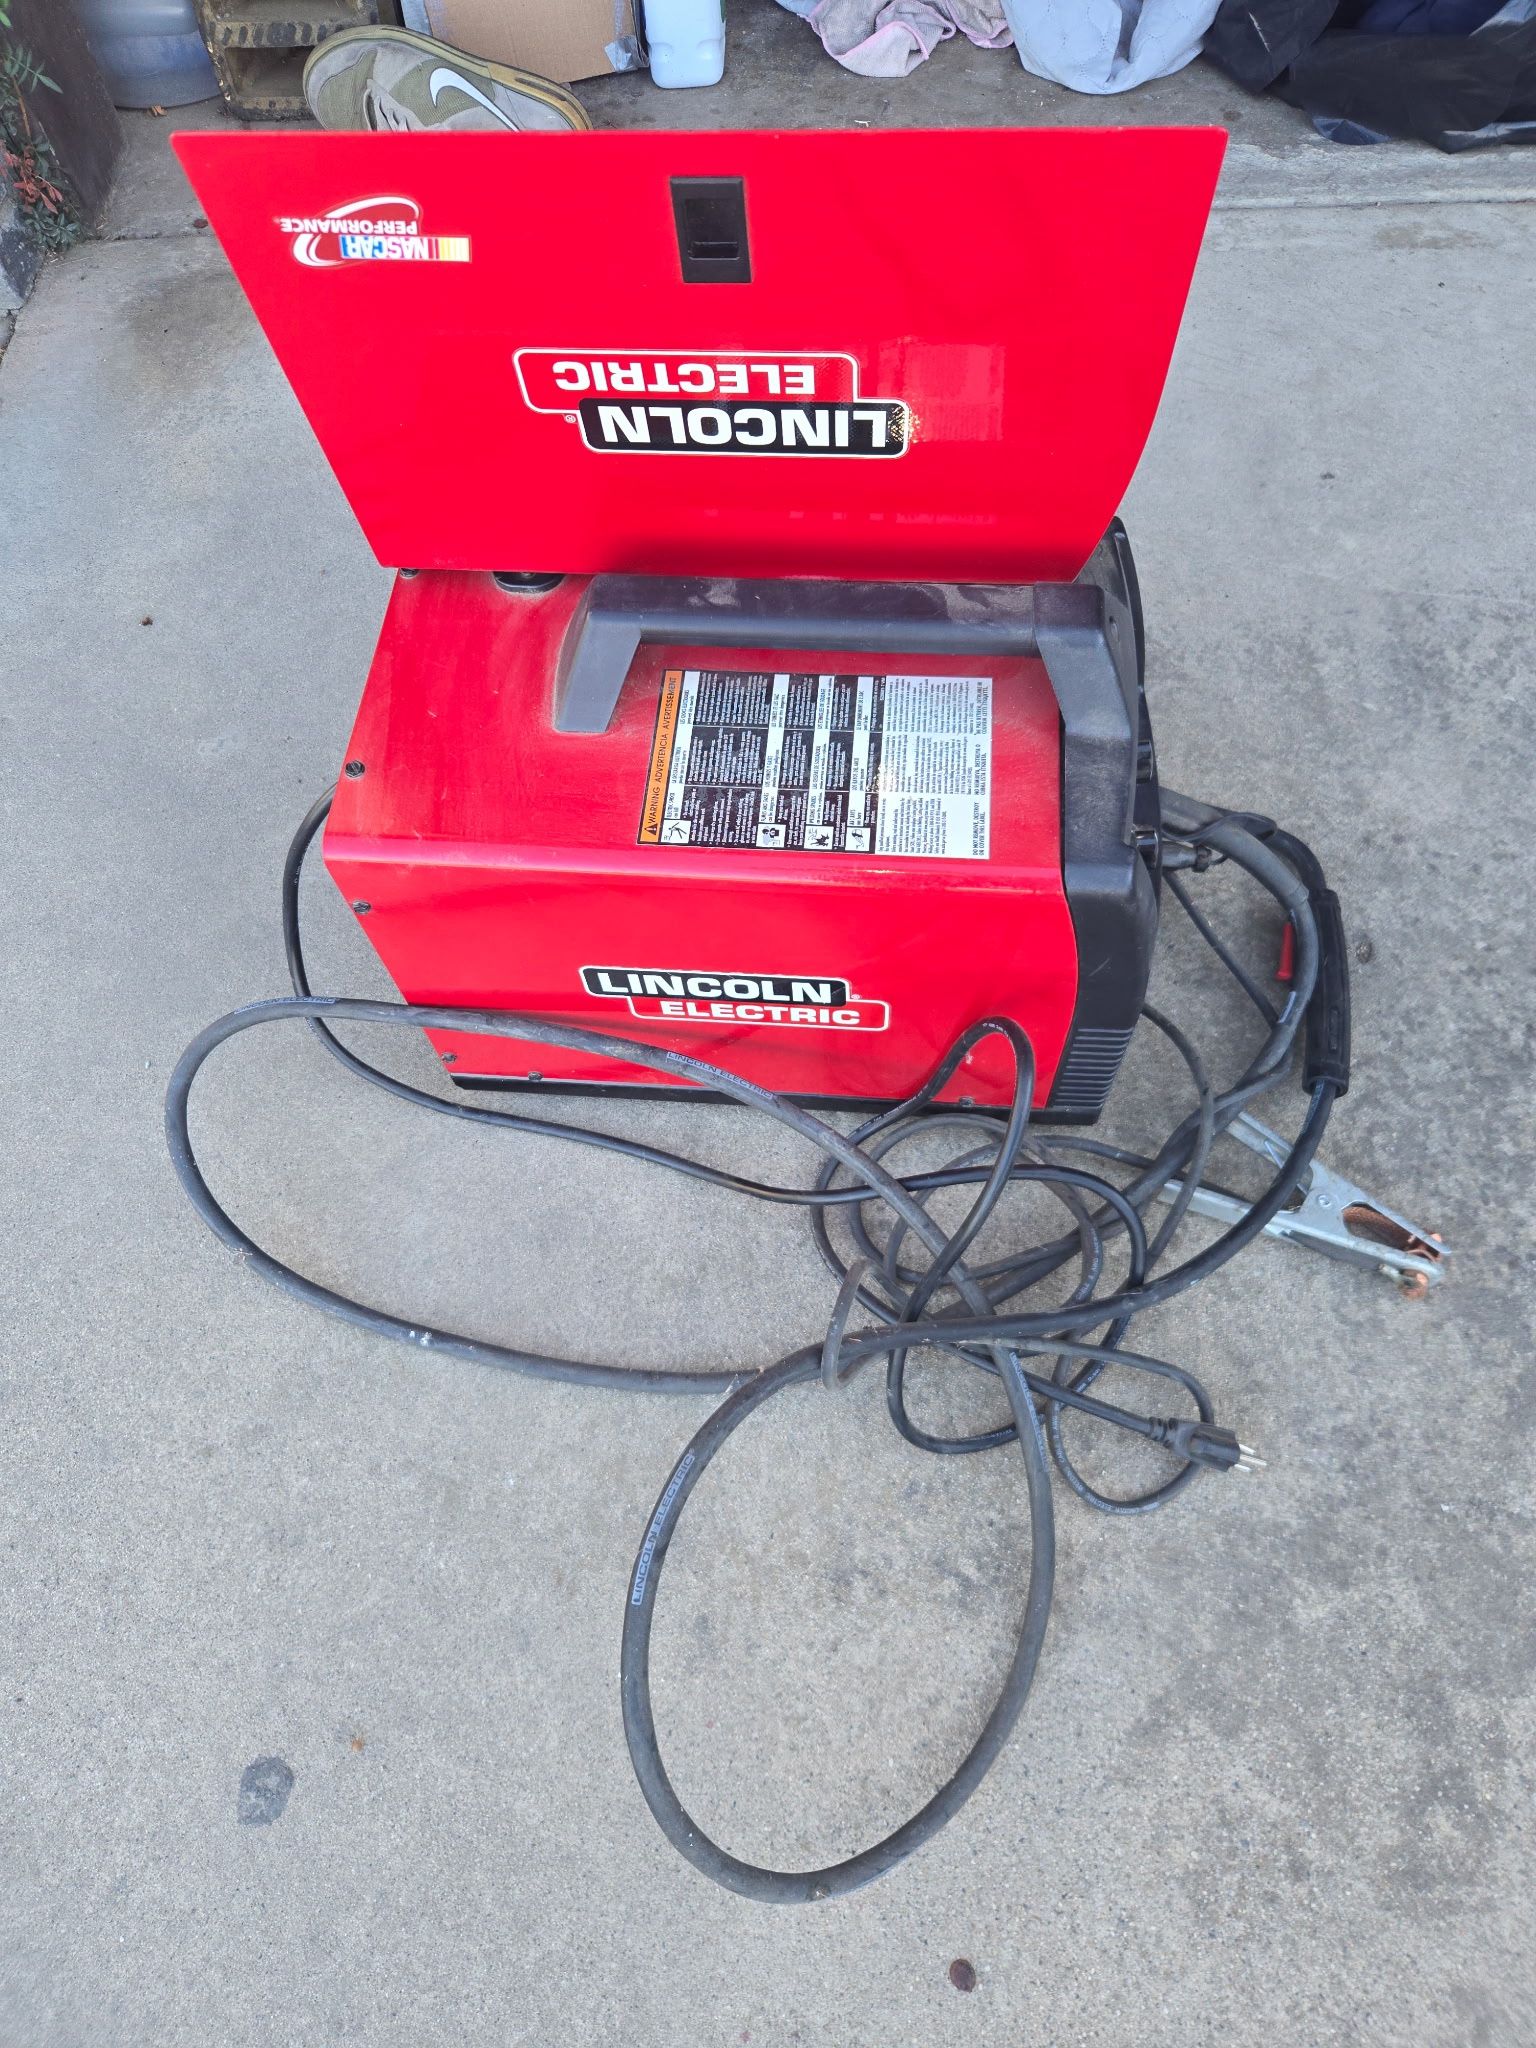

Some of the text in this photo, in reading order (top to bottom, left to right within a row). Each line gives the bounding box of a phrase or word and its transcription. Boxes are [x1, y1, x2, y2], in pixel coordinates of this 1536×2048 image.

[281, 218, 417, 234] PERFORMANCE
[344, 235, 428, 259] NASCAR
[553, 362, 815, 394] ELECTRIC
[598, 406, 887, 447] LINCOLN
[648, 677, 677, 824] WARNING ADVERTENCIA AVERTISSEMENT
[597, 972, 832, 1004] LINCOLN
[660, 1001, 860, 1025] ELECTRIC
[668, 1052, 773, 1099] LINCOLN ELECTRIC
[633, 1455, 694, 1603] LINCOLN ELECTRIC
